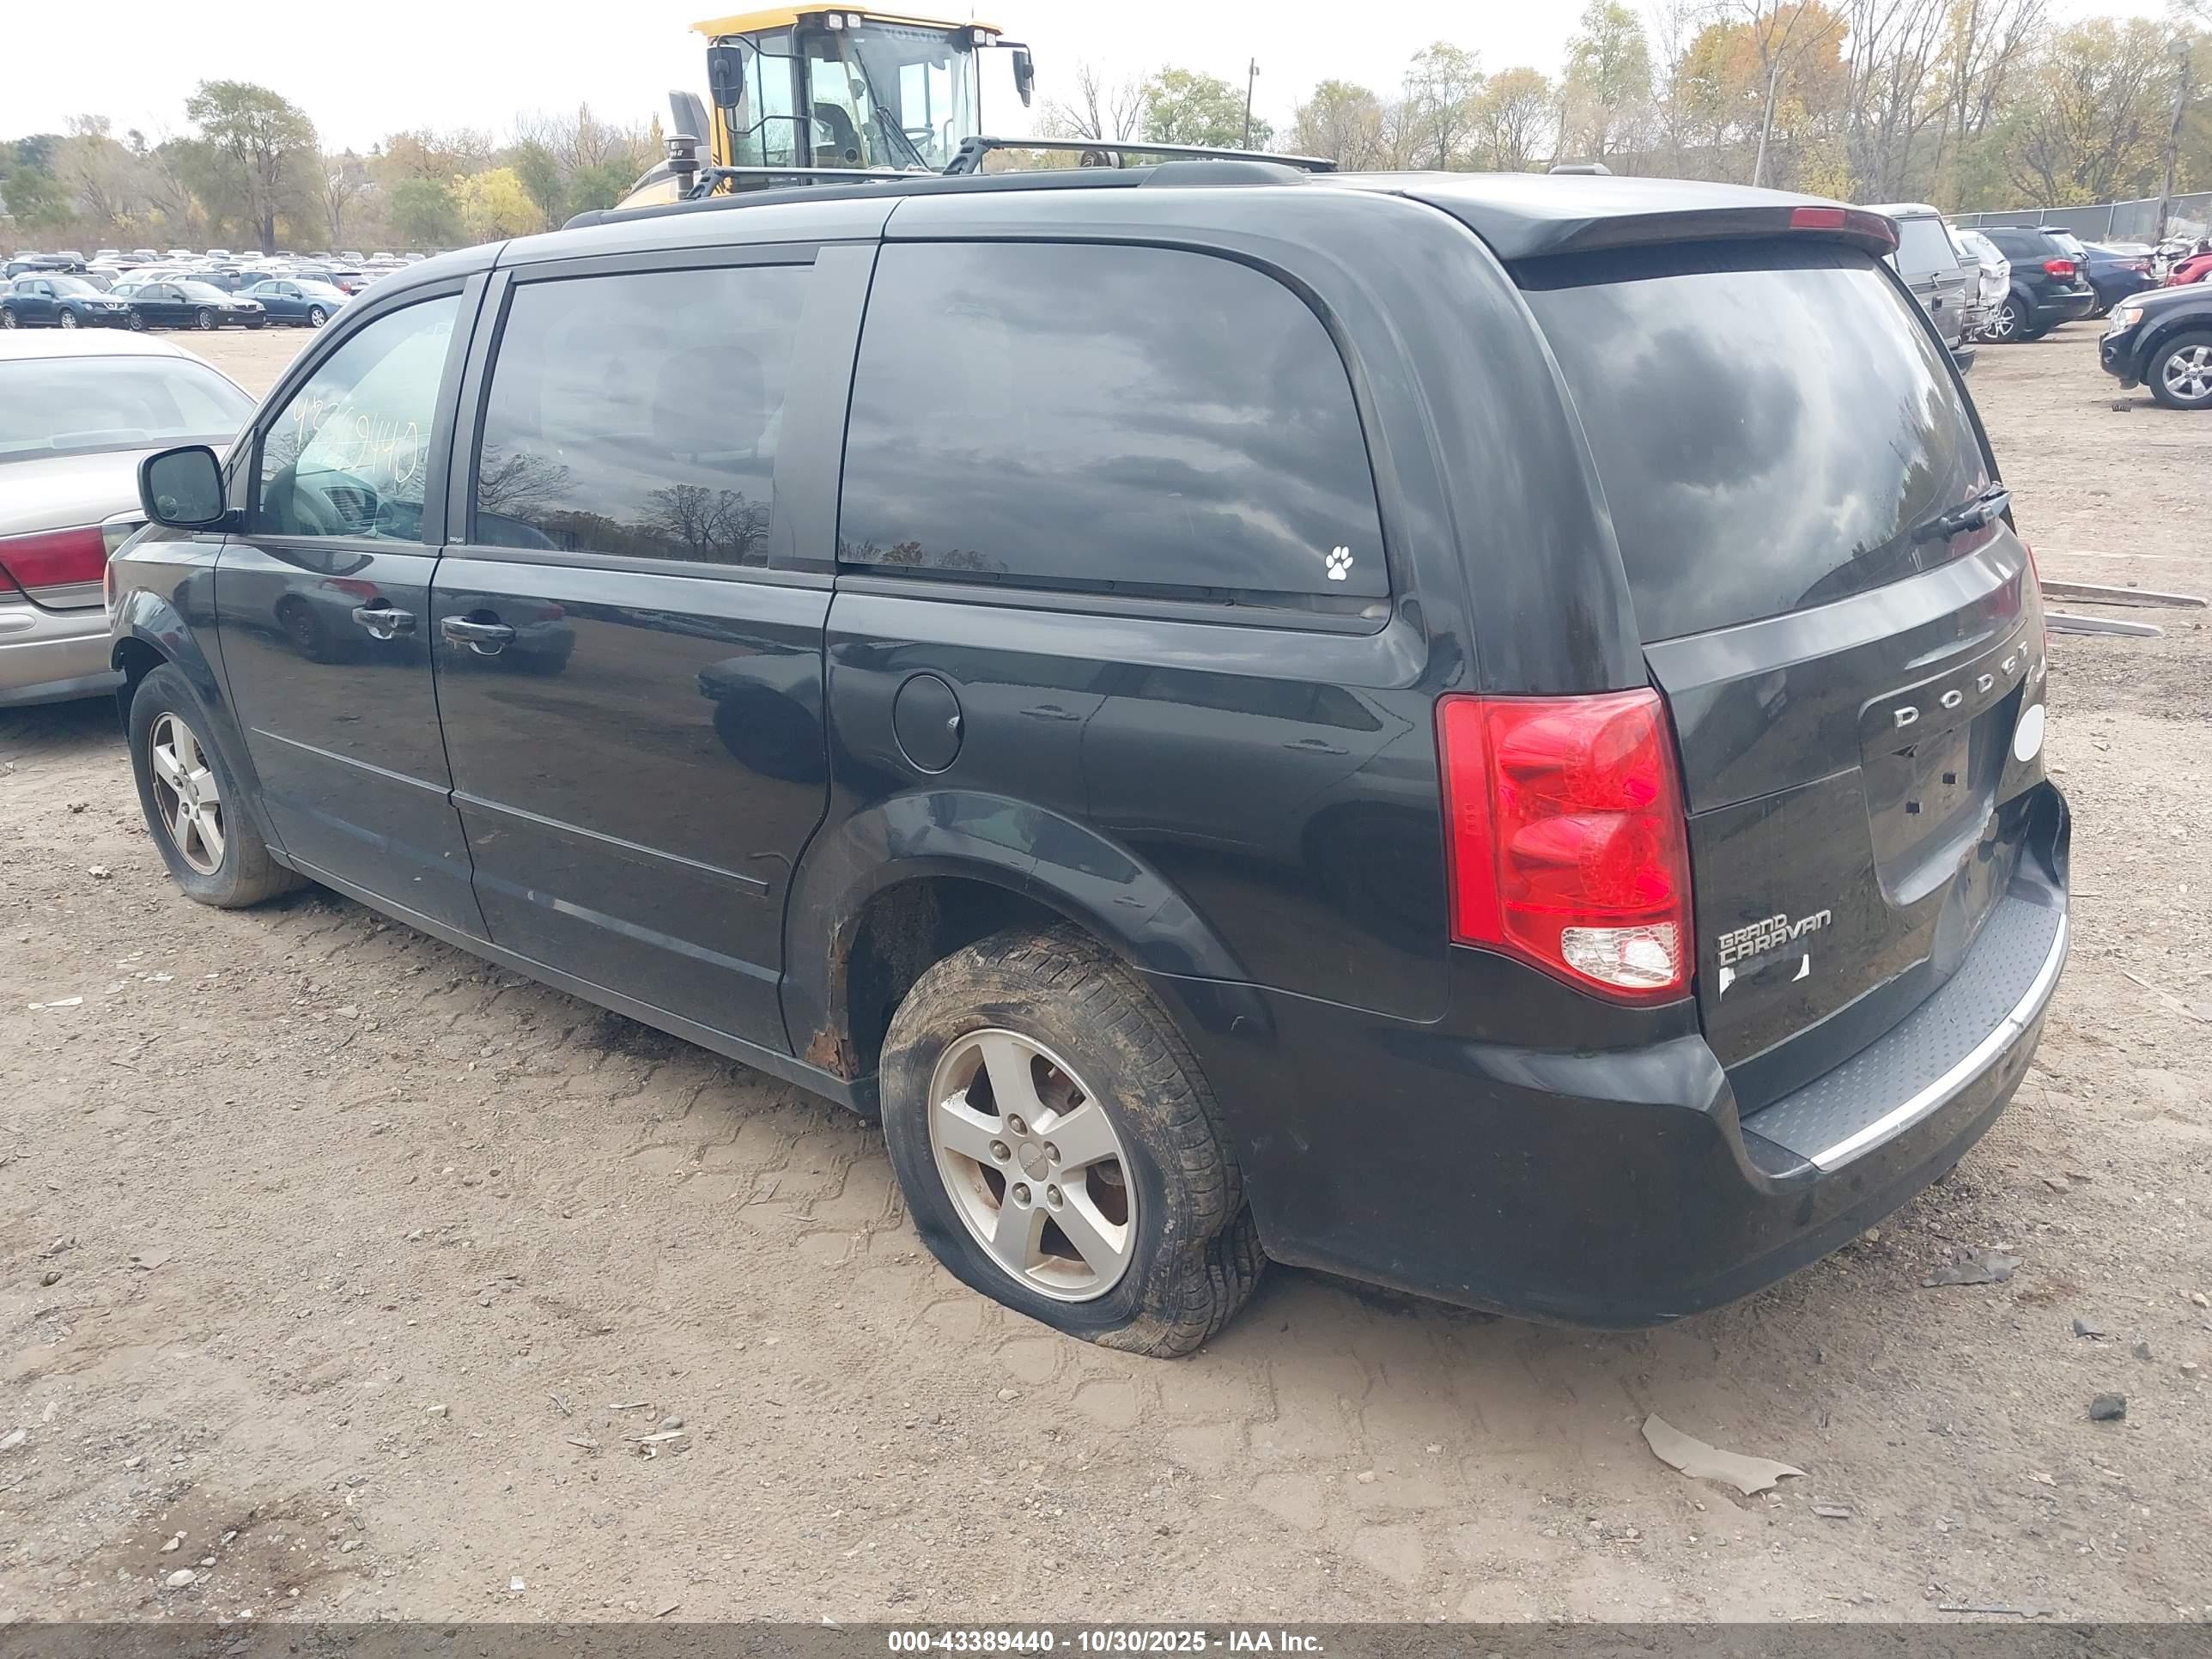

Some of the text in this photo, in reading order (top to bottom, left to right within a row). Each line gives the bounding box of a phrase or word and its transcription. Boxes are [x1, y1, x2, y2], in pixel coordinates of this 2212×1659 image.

[1893, 640, 2028, 728] DODGE
[1717, 913, 1788, 950] GRAND
[1717, 908, 1832, 968] CARAVAN
